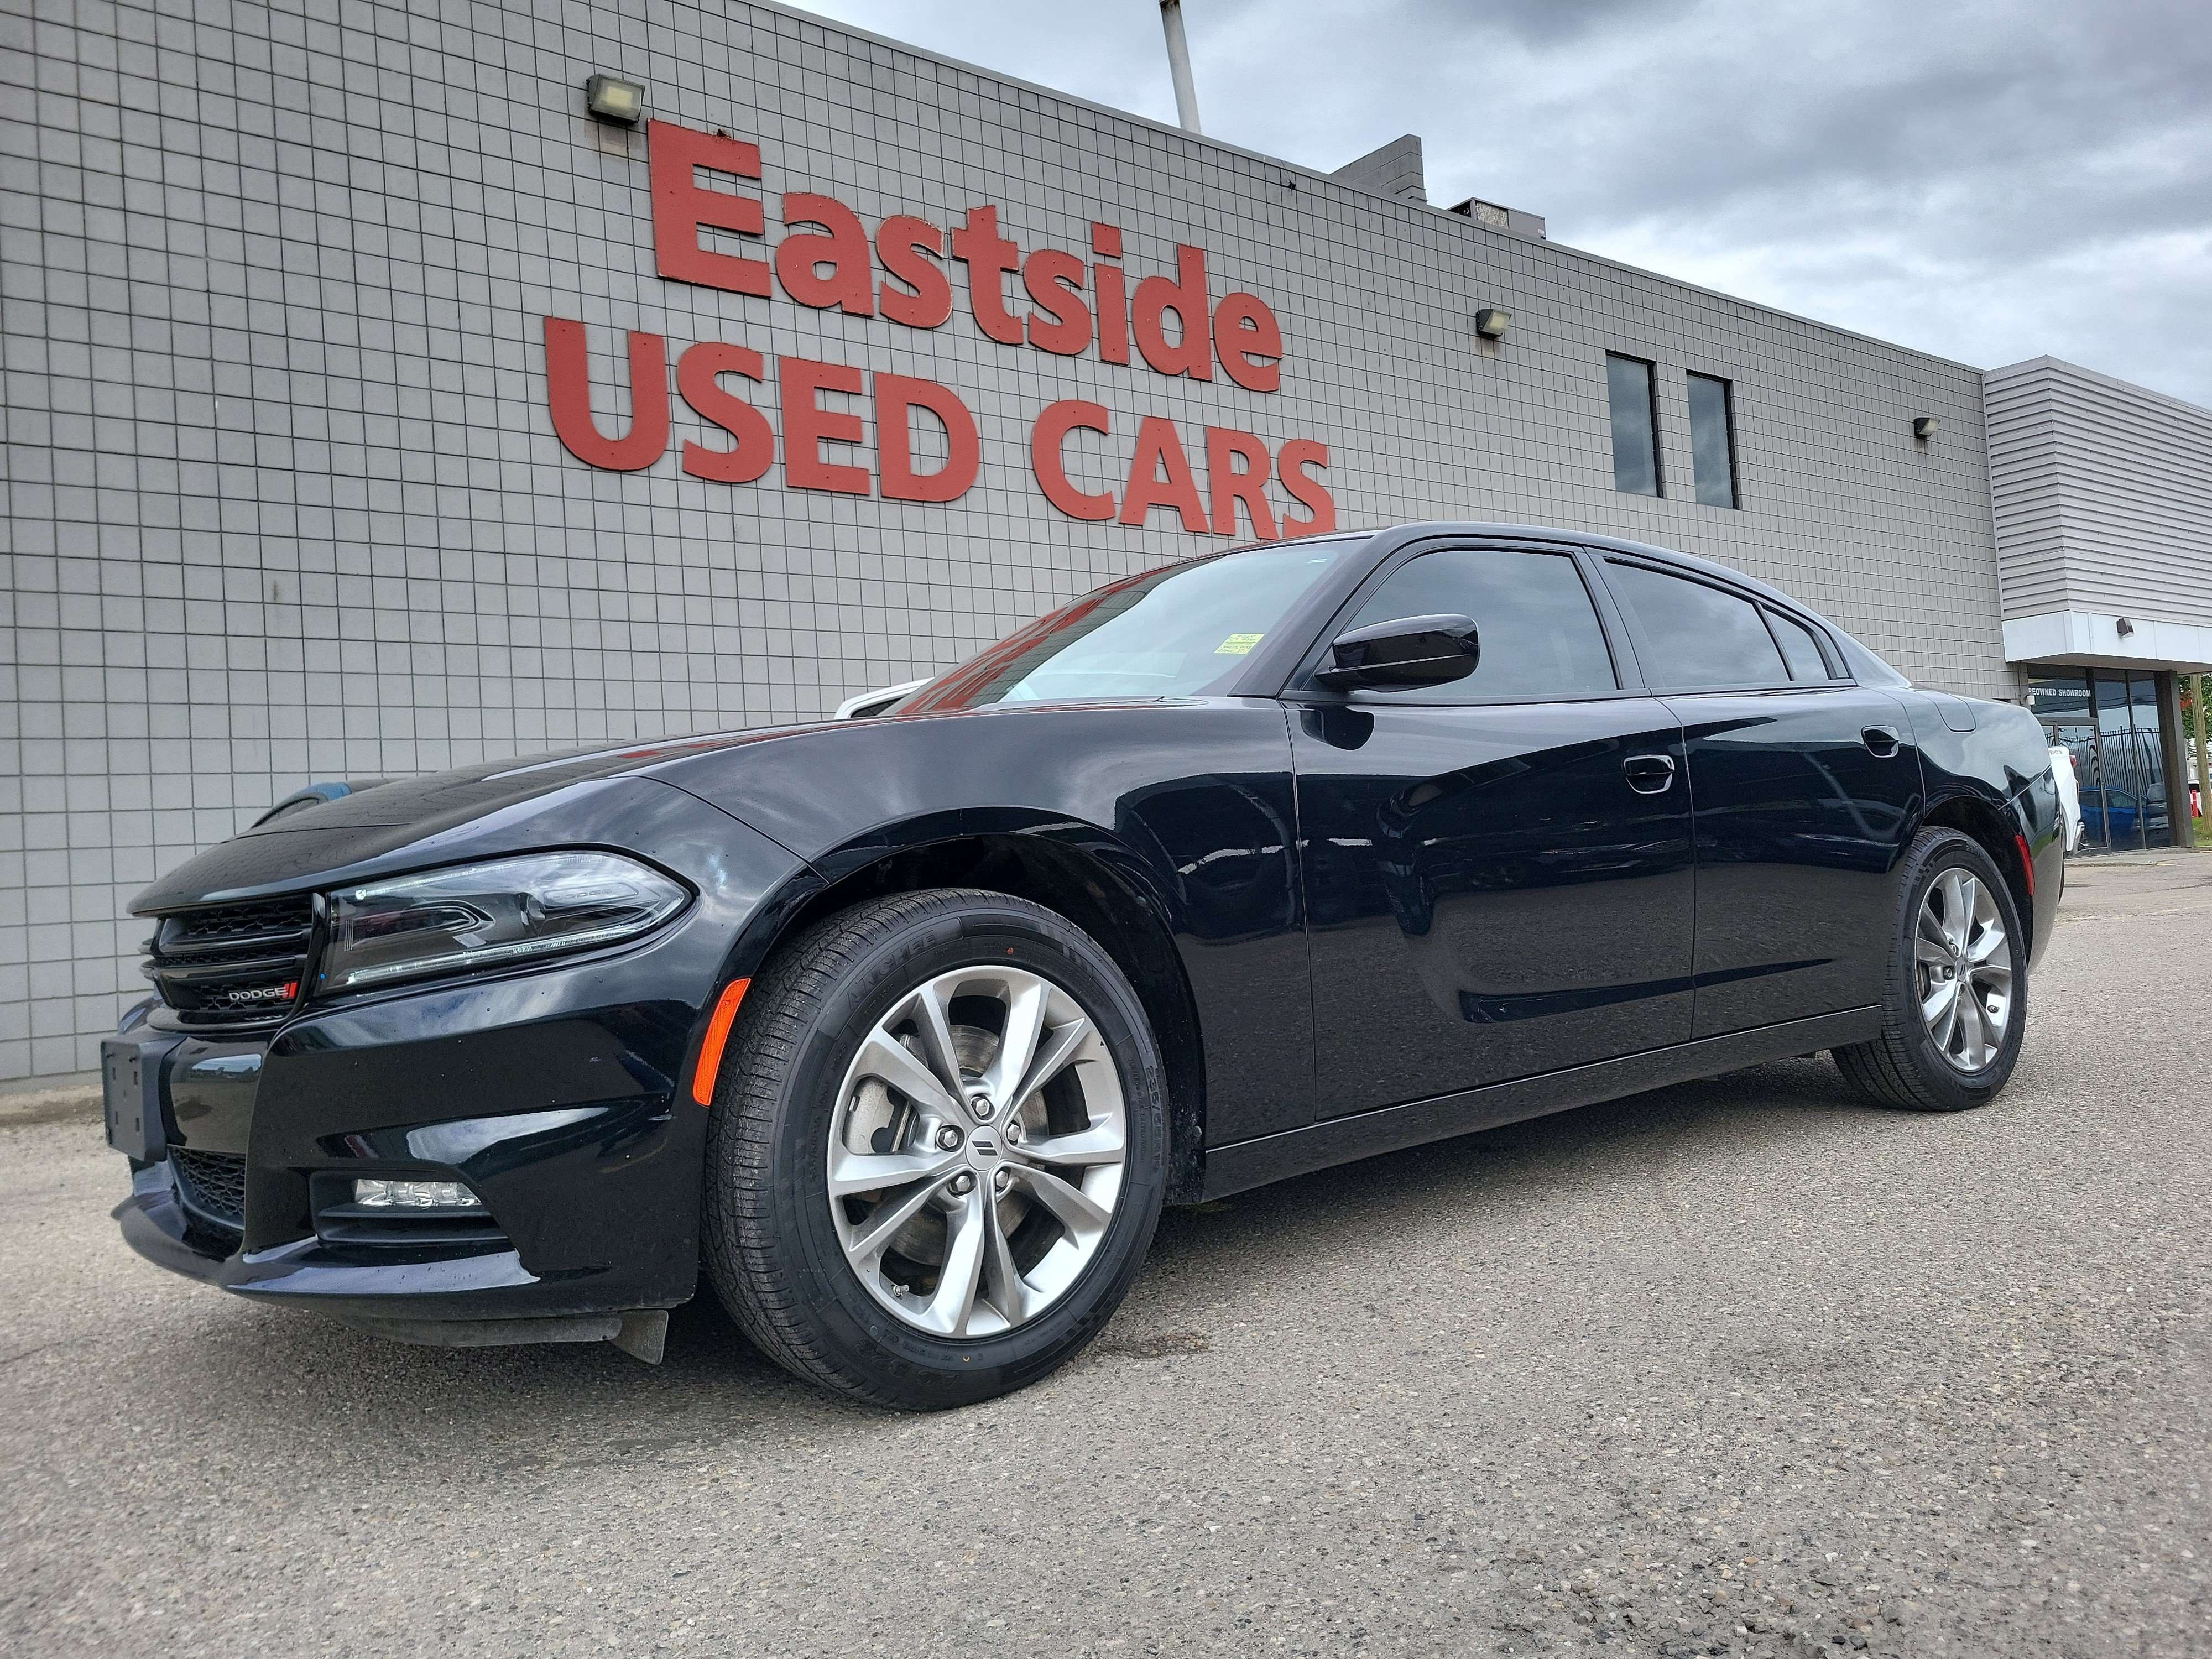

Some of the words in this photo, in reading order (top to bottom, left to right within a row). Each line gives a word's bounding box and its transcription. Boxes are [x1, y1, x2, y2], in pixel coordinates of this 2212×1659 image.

[647, 118, 1283, 393] Eastside
[544, 316, 979, 503] USED
[1031, 399, 1335, 540] CARS
[2058, 688, 2091, 697] SHOWROOM
[229, 987, 289, 1001] DODGE
